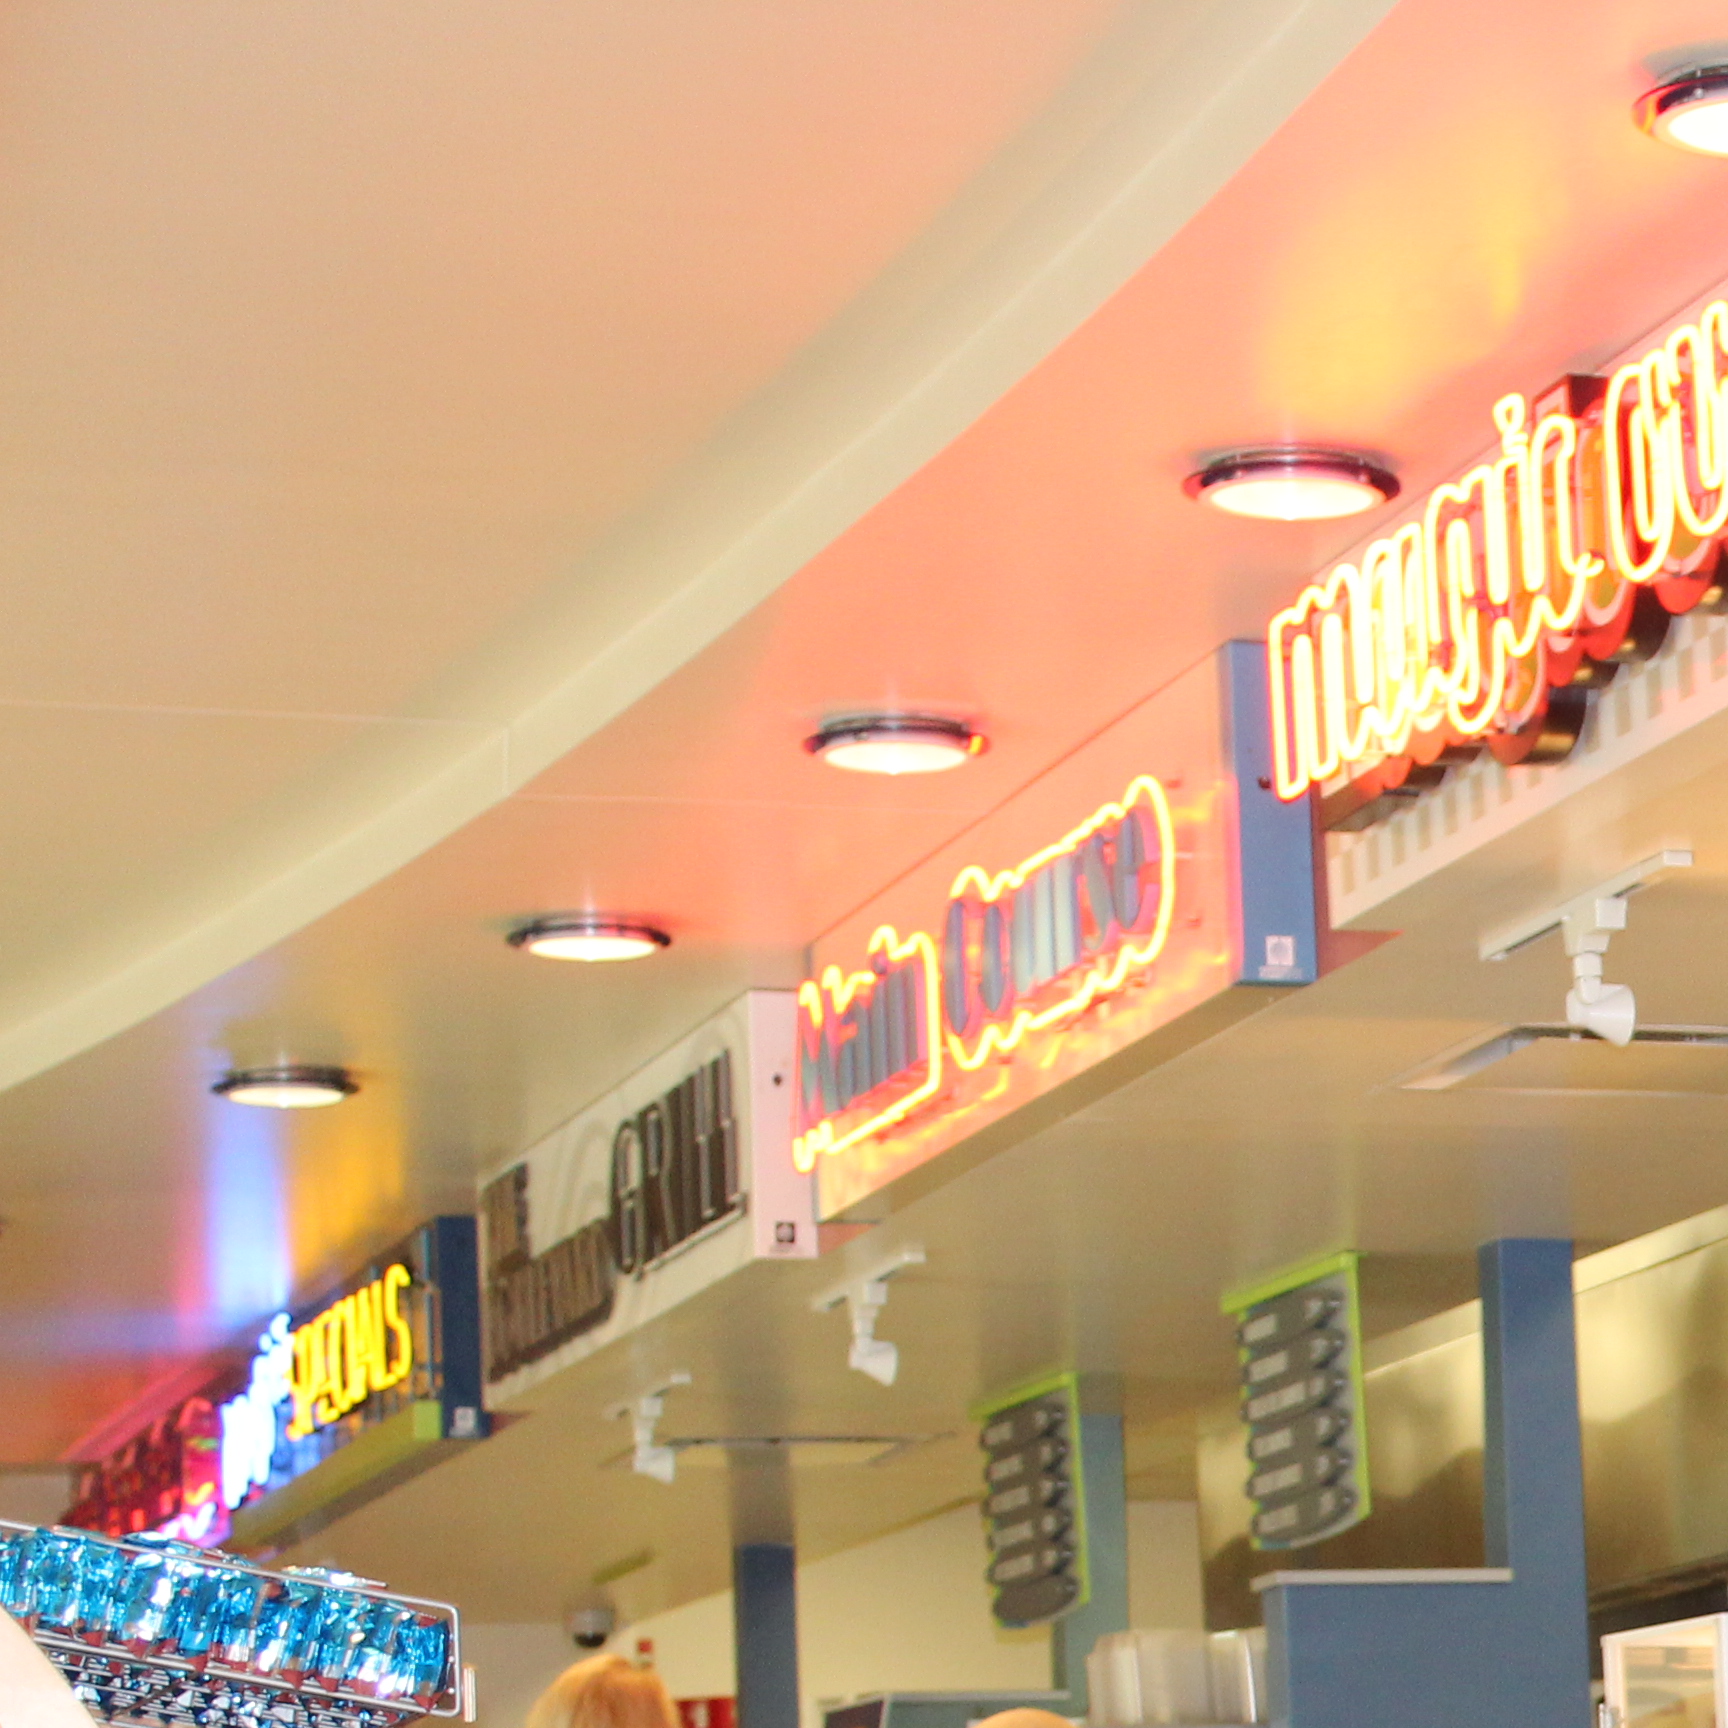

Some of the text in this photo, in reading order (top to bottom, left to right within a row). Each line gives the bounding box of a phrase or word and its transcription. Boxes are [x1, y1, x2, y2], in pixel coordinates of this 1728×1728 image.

[1266, 392, 1603, 800] magic
[799, 807, 1148, 1120] Main Course
[611, 1048, 742, 1282] GRILL
